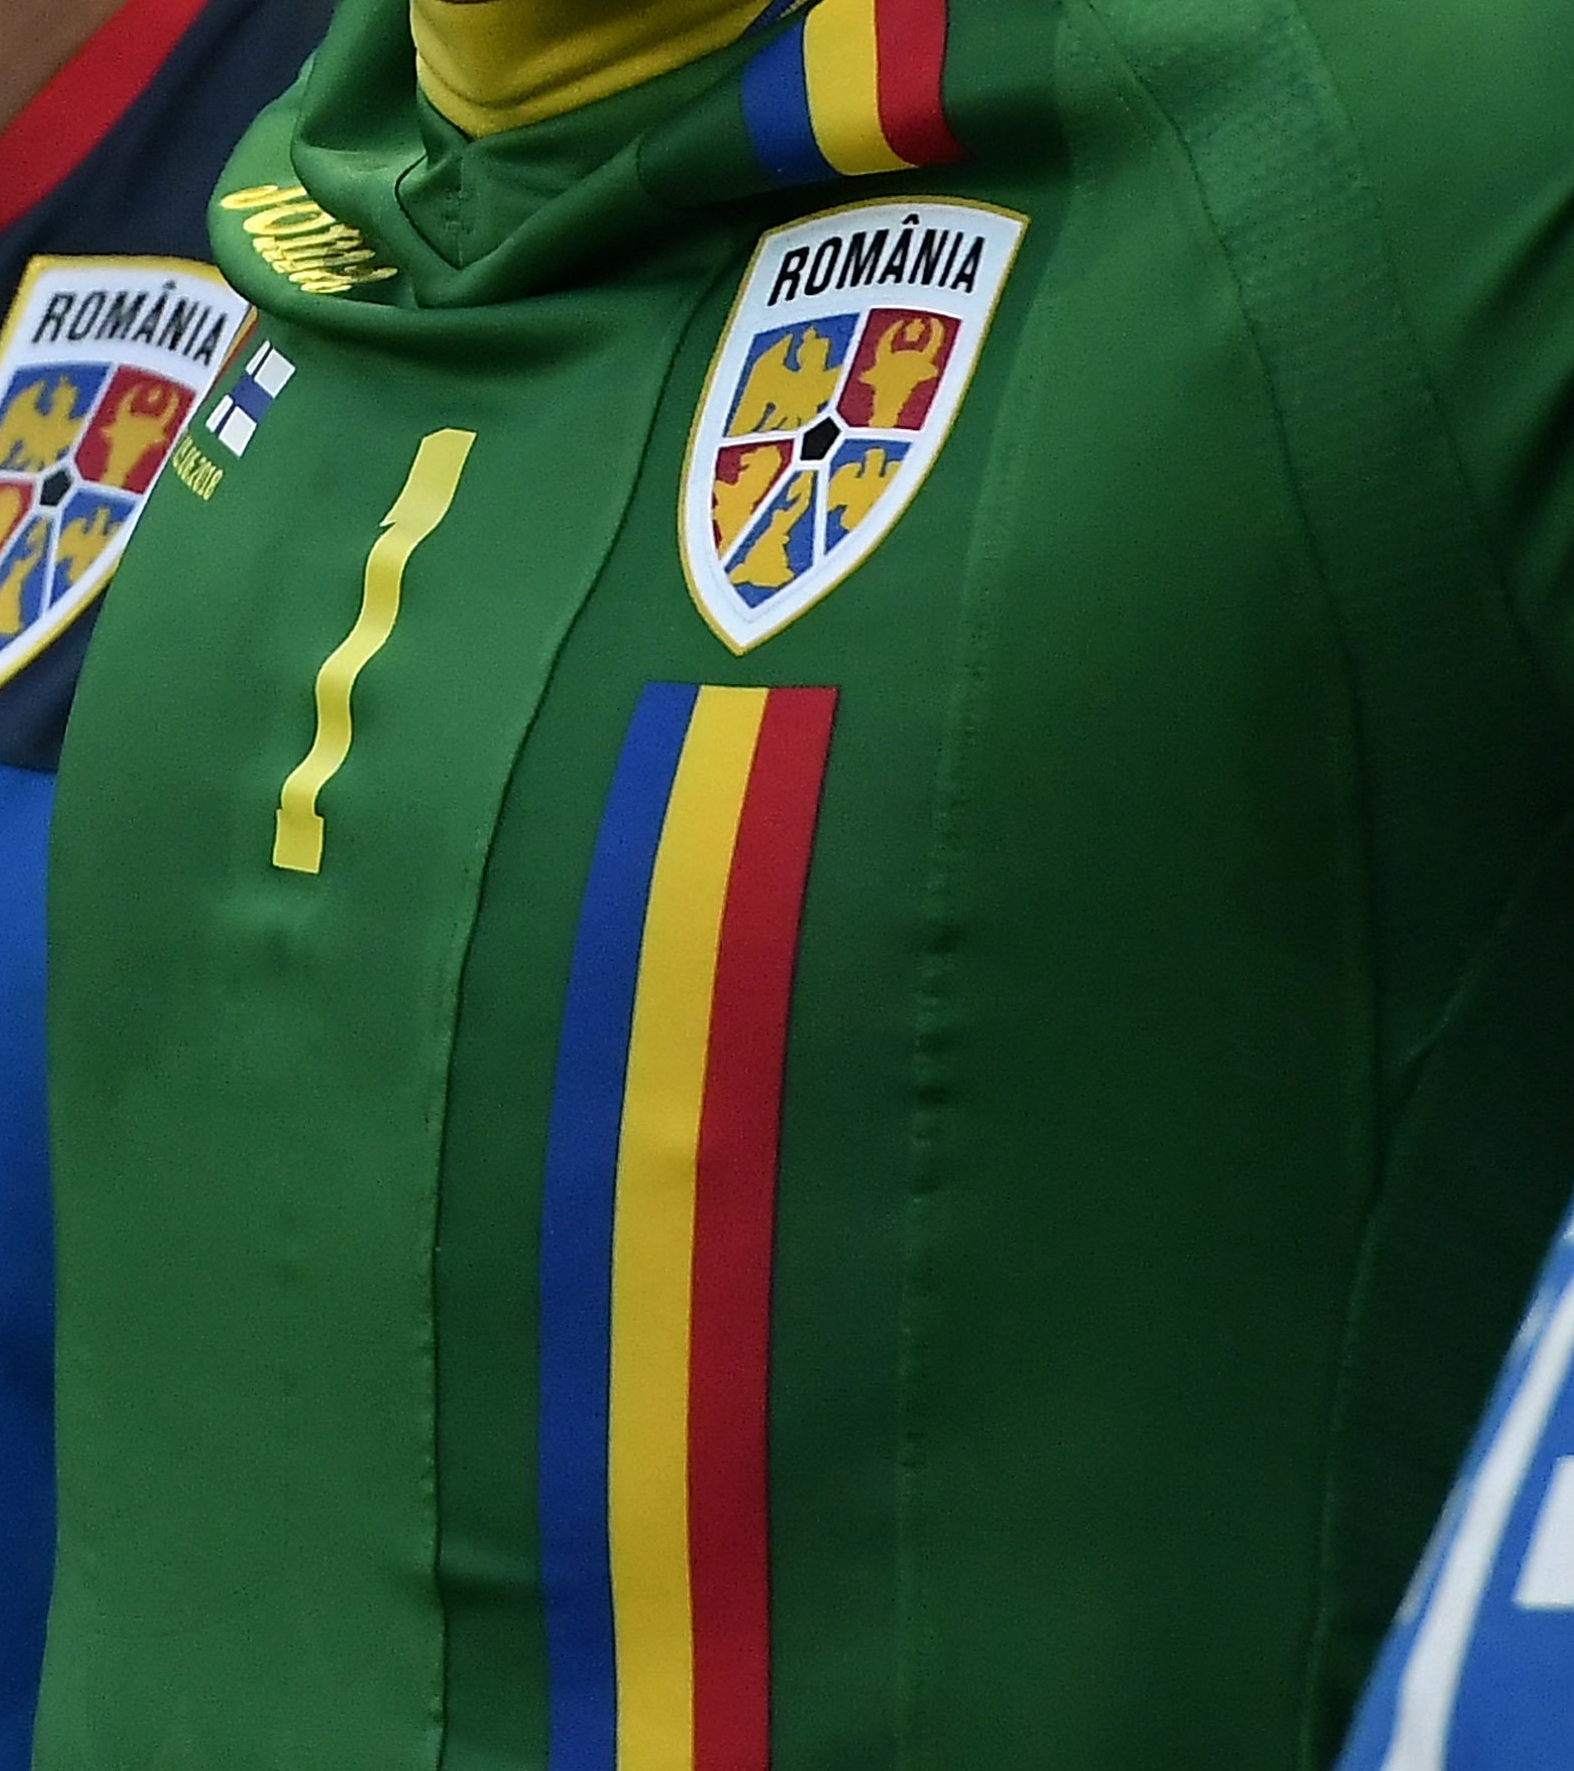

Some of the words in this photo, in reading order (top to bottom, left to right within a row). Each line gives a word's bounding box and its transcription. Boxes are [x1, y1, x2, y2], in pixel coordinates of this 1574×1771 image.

[766, 213, 986, 307] ROMÂNIA
[31, 279, 228, 367] ROMÂNIA
[273, 428, 476, 874] 1
